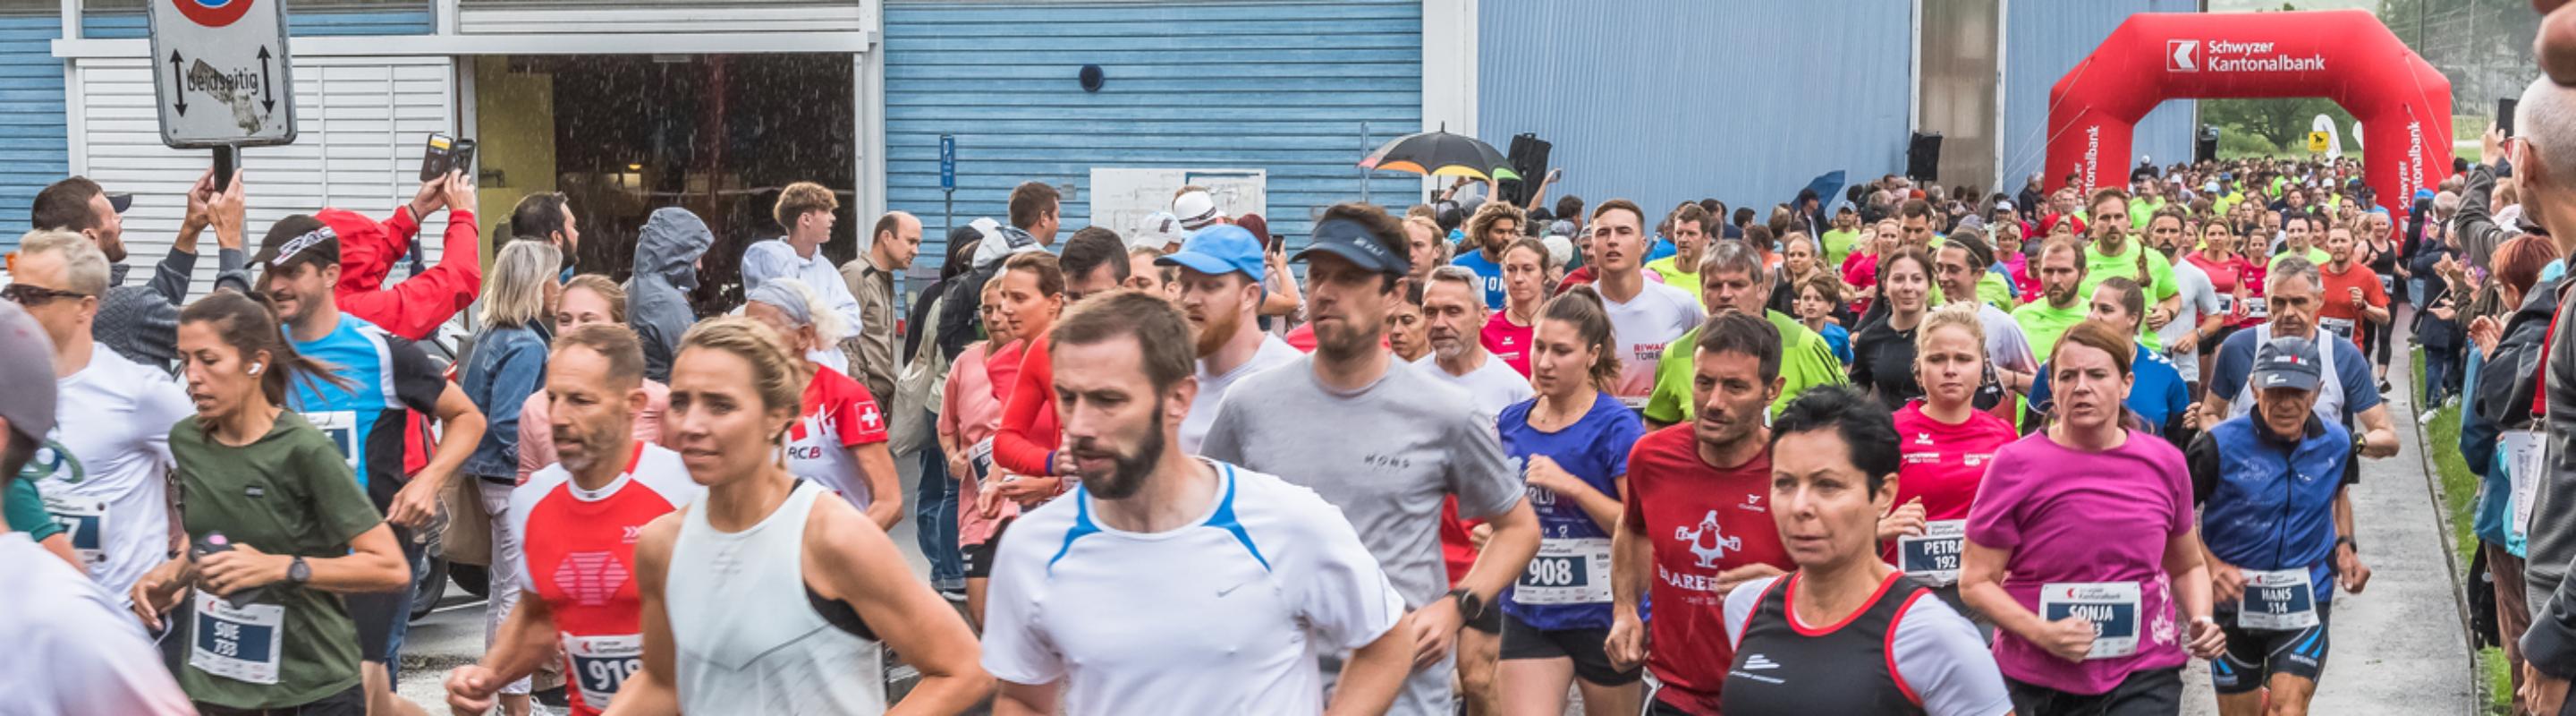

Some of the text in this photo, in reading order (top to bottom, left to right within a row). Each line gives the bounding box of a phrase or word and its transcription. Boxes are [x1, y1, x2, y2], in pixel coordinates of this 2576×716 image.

[2208, 40, 2275, 56] Schwyzer
[2208, 55, 2326, 72] Kantonalbank
[186, 67, 258, 96] beidseitig
[2399, 161, 2410, 209] Schwyzer
[1924, 540, 1964, 555] PETRA
[1935, 556, 1957, 569] 192
[1529, 558, 1572, 585] 908
[2261, 587, 2292, 601] HANS
[2069, 604, 2114, 621] SONJA
[2268, 601, 2288, 614] 514
[214, 621, 240, 640] SUE
[214, 638, 238, 656] 733
